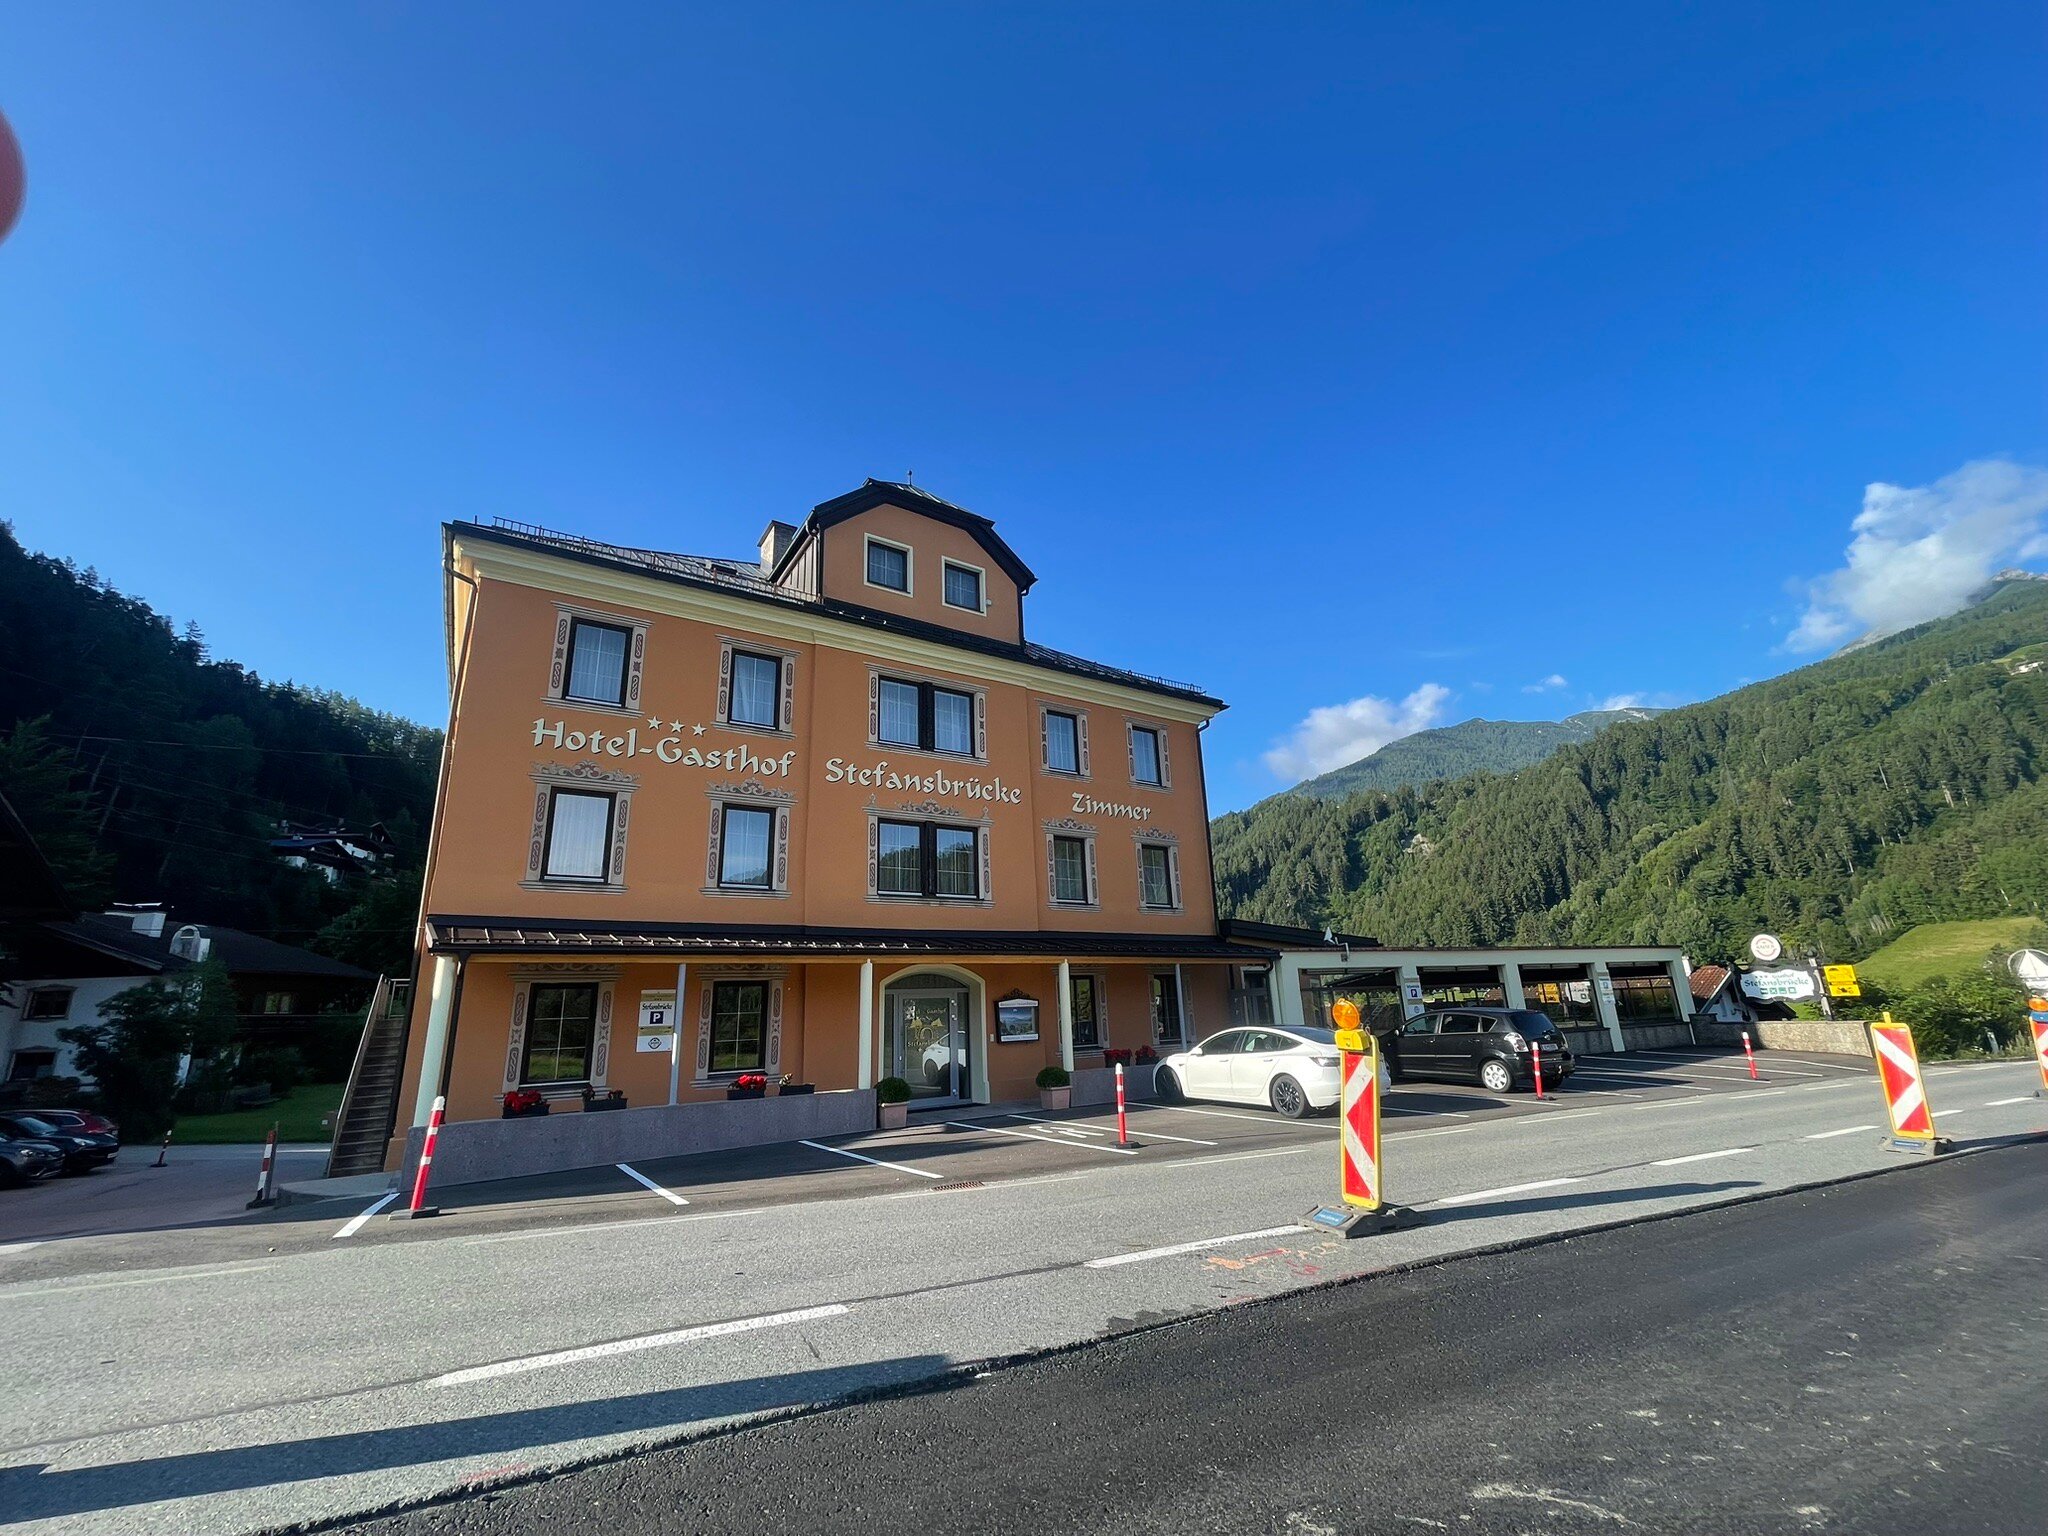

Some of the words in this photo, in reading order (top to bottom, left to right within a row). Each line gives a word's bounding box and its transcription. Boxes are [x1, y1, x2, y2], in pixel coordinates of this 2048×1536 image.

[530, 718, 797, 778] Hotel-Gasthof
[824, 757, 1023, 805] Stefansbrücke
[1071, 791, 1152, 822] Zimmer
[1744, 977, 1809, 987] Stefansbrücke
[652, 1012, 661, 1023] P
